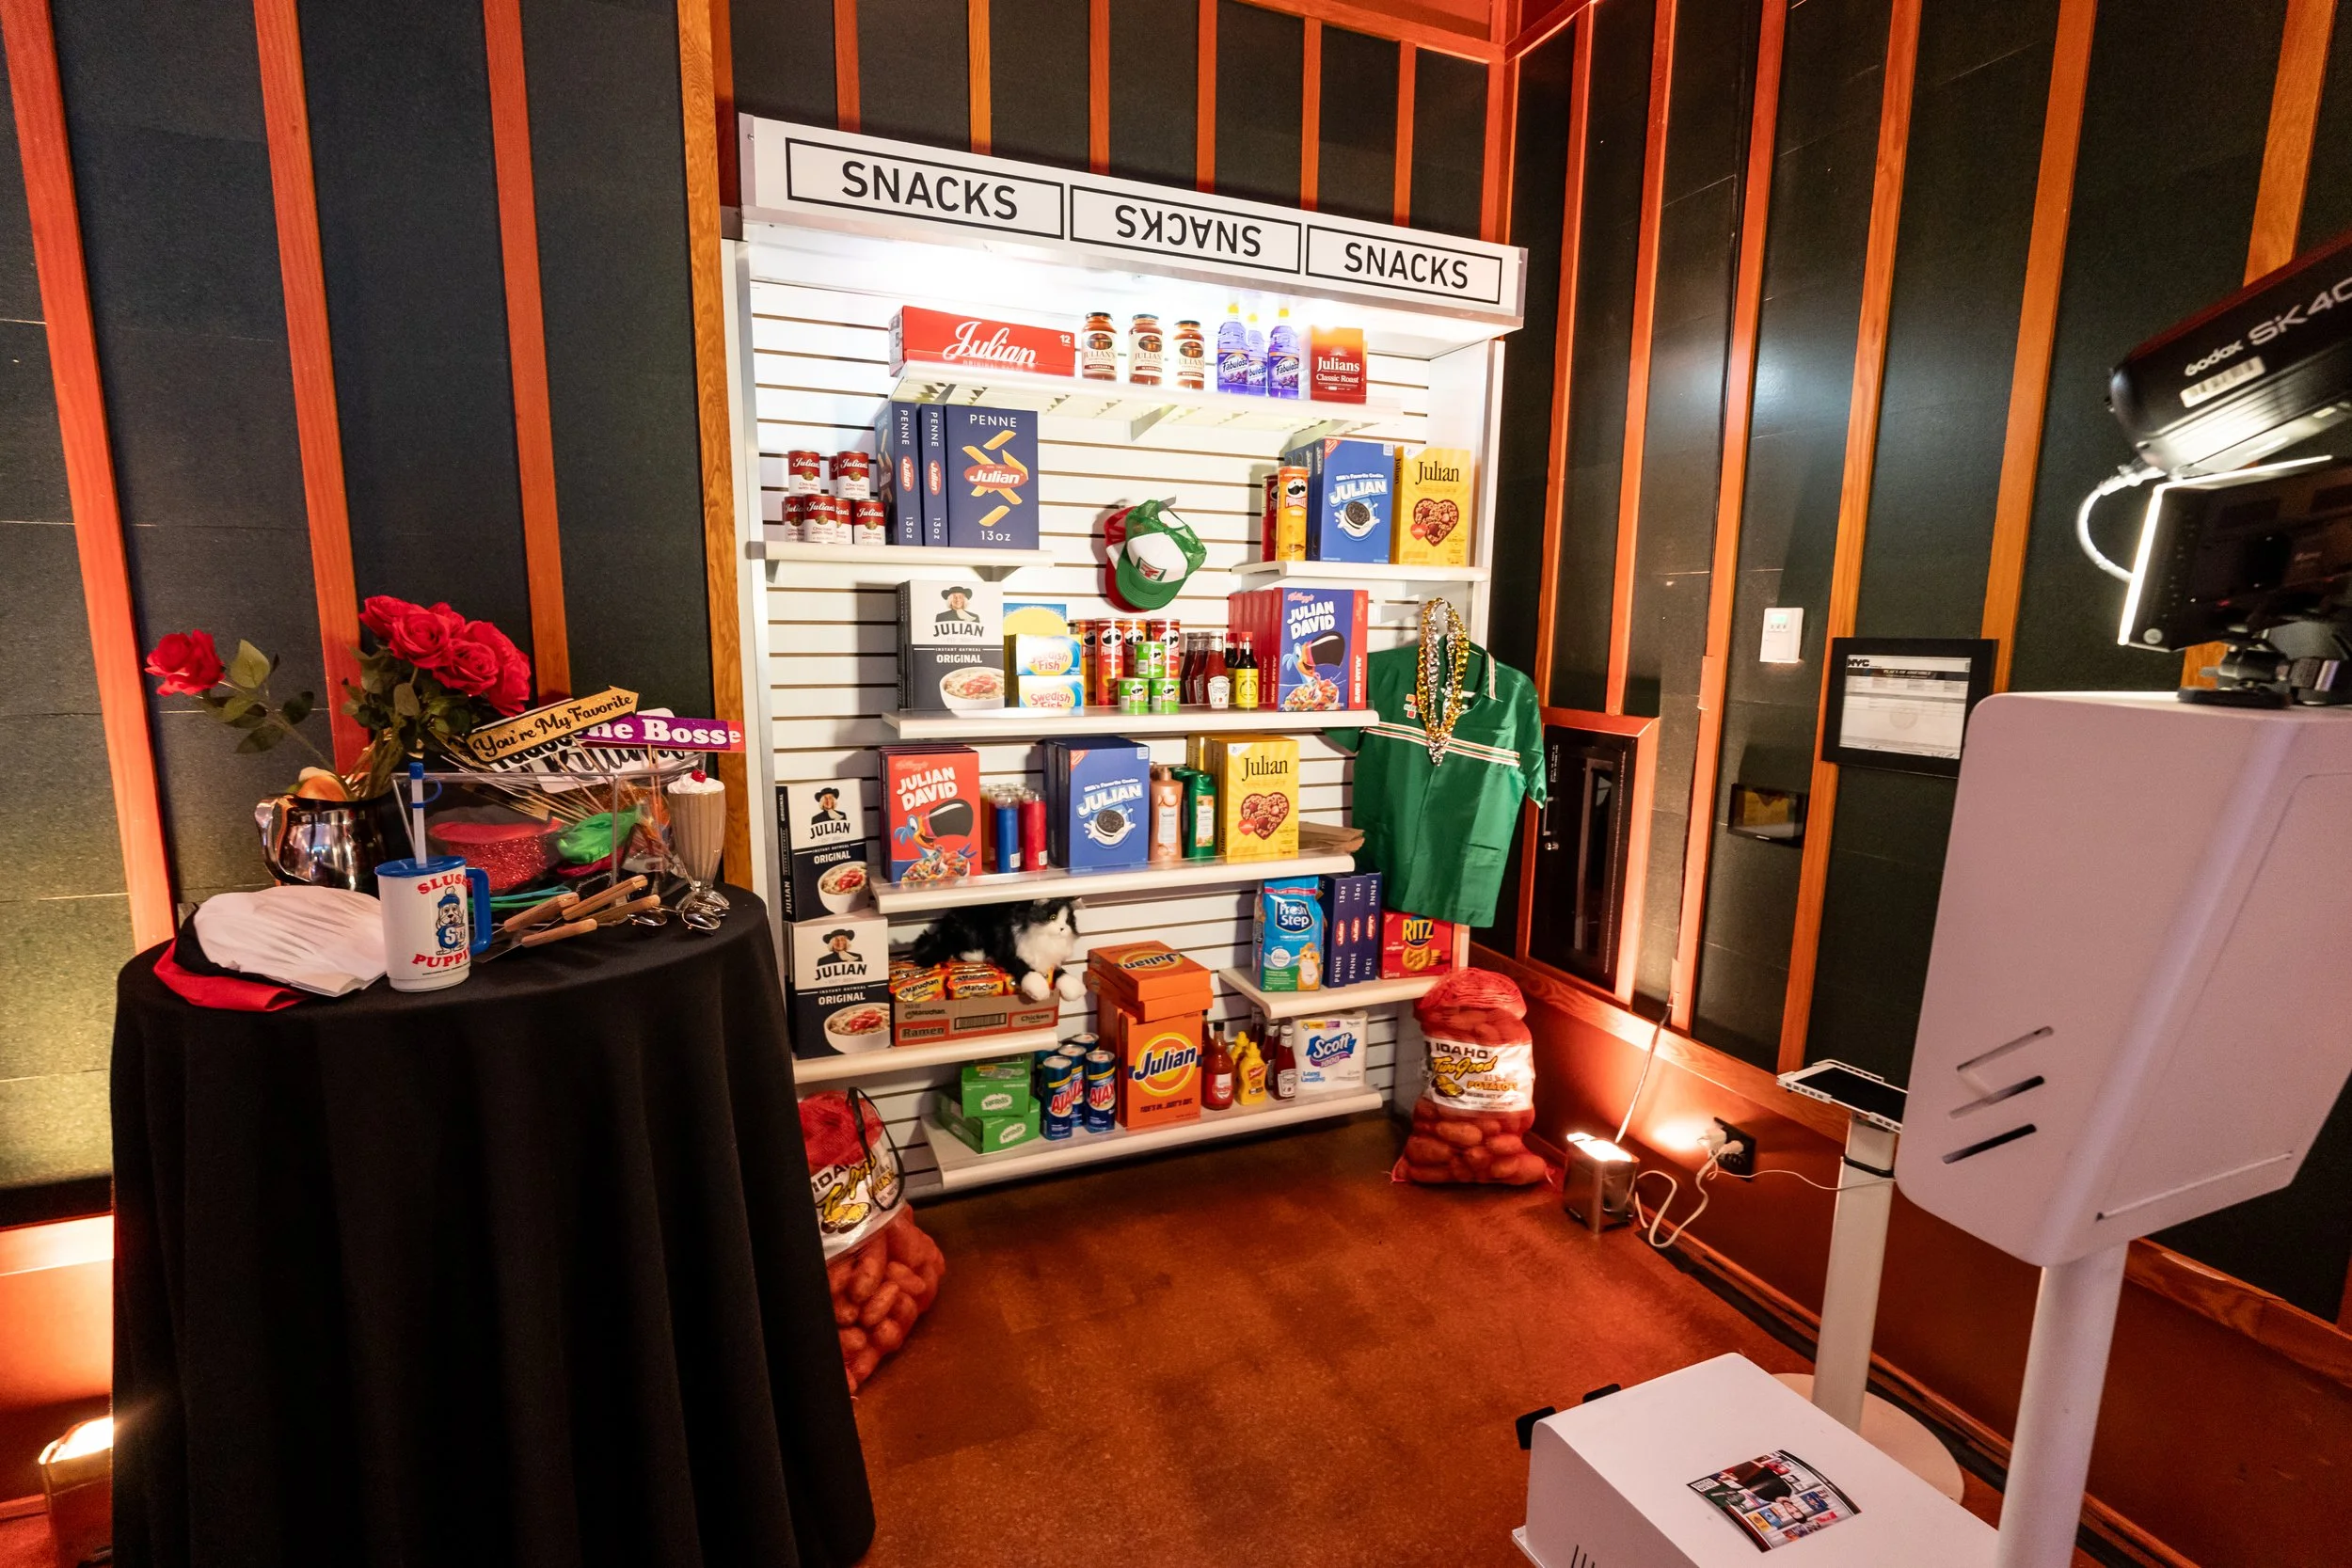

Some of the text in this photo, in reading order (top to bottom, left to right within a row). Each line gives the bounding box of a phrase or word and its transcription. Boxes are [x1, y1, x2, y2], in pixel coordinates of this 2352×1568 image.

[840, 158, 1018, 222] SNACKS
[1115, 205, 1262, 258] SNACKS
[1343, 242, 1469, 290] SNACKS
[942, 321, 1036, 365] Julian
[1059, 334, 1071, 343] 12
[1317, 356, 1360, 372] Julians
[2184, 340, 2245, 376] Godox
[1249, 365, 1266, 377] buloso
[1315, 373, 1359, 384] Classic Roast
[900, 409, 910, 446] PENNE
[930, 411, 939, 447] PENNE
[970, 414, 1017, 428] PENNE
[901, 458, 910, 490] Julian
[968, 469, 1021, 484] Julian
[1415, 461, 1459, 485] Julian
[1330, 481, 1387, 504] JULIAN
[1287, 601, 1335, 624] JULIAN
[932, 624, 985, 638] JULIAN
[1290, 614, 1335, 640] DAVID
[936, 654, 983, 664] ORIGINAL
[1038, 660, 1060, 671] Fish
[1847, 658, 1870, 667] NYC
[1030, 690, 1071, 706] Swedish
[472, 726, 536, 754] You're
[534, 713, 572, 736] My
[571, 694, 634, 721] Favorite
[577, 718, 634, 741] he
[643, 719, 727, 745] Boss
[1241, 755, 1288, 782] Julian
[896, 767, 956, 795] JULIAN
[1084, 784, 1101, 793] Milk's
[1100, 780, 1121, 789] Favorite
[901, 782, 958, 811] DAVID
[1077, 784, 1142, 817] JULIAN
[810, 822, 850, 840] JULIAN
[814, 850, 851, 864] ORIGINAL
[1279, 901, 1308, 916] Fresh
[1280, 914, 1310, 928] Step
[1403, 919, 1434, 942] RITZ
[412, 946, 469, 968] PUPPI
[1123, 953, 1177, 970] Julian
[815, 962, 867, 981] JULIAN
[905, 978, 939, 993] Maruchan
[964, 983, 998, 992] Maruchan
[818, 991, 866, 1006] ORIGINAL
[1021, 1013, 1049, 1022] Chicken
[901, 1026, 945, 1037] Ramen
[1312, 1034, 1351, 1058] Scott
[1435, 1042, 1488, 1059] IDAHO
[1134, 1045, 1197, 1081] Julian
[1089, 1084, 1115, 1106] AJAX
